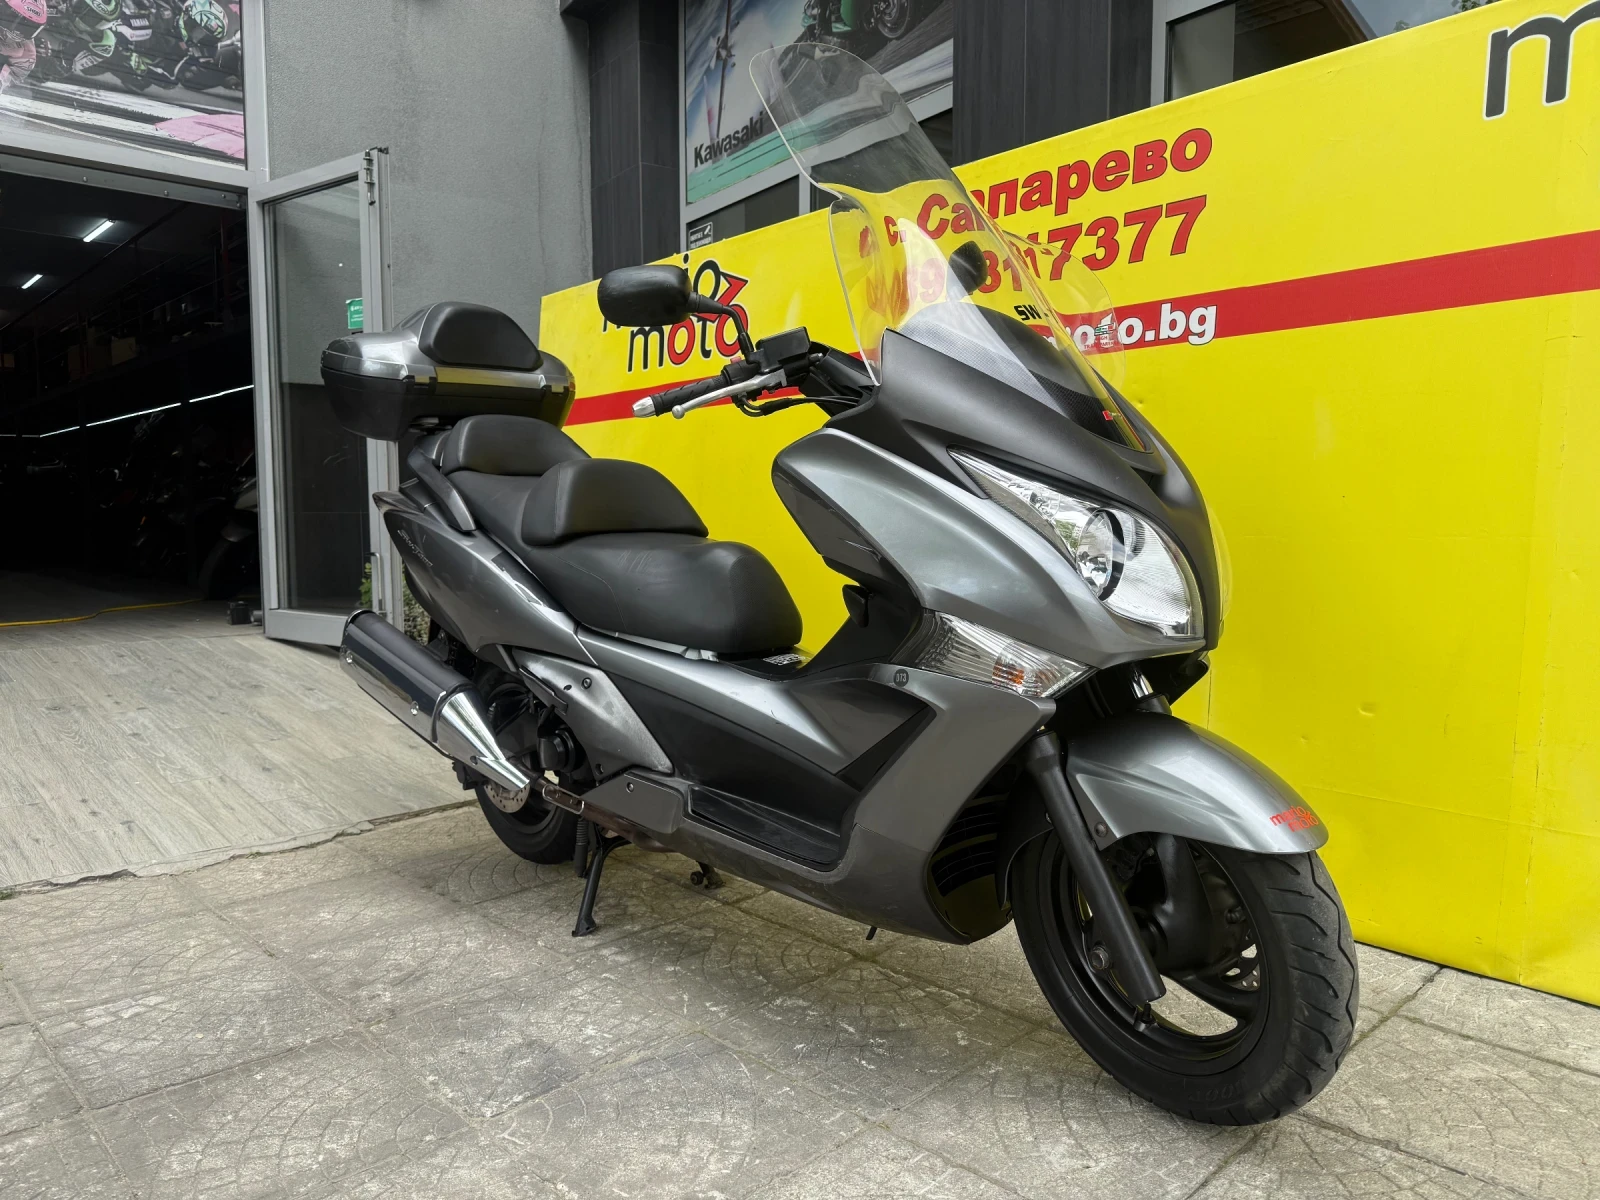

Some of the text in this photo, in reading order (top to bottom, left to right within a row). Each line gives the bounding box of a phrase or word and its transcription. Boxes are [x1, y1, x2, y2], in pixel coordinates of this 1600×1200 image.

[694, 111, 764, 168] Kawasaki
[917, 127, 1213, 240] Сапарево
[1269, 805, 1307, 827] mario
[1287, 811, 1319, 833] moto
